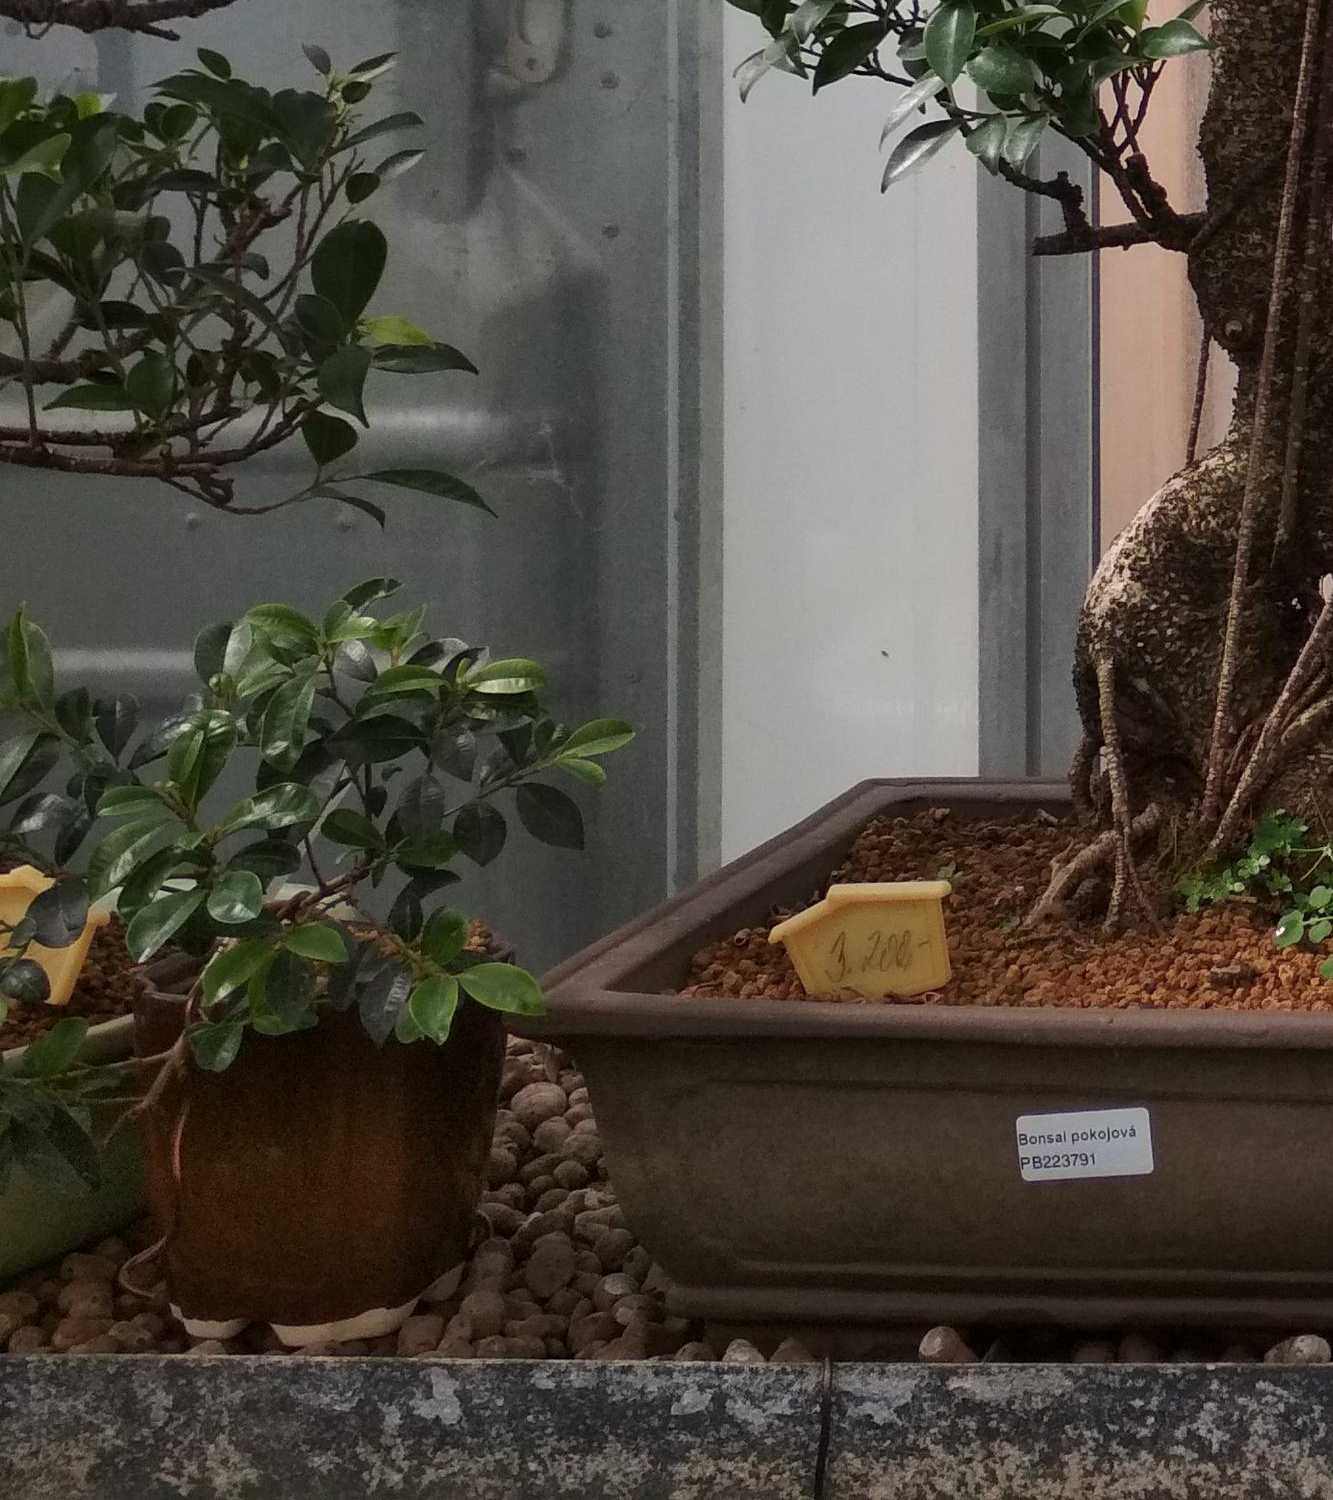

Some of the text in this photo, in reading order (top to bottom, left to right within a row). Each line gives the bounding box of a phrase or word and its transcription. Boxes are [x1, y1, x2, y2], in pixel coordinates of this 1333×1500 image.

[1018, 1125, 1137, 1146] Bonsai pokojová
[1020, 1153, 1096, 1170] PB223791
